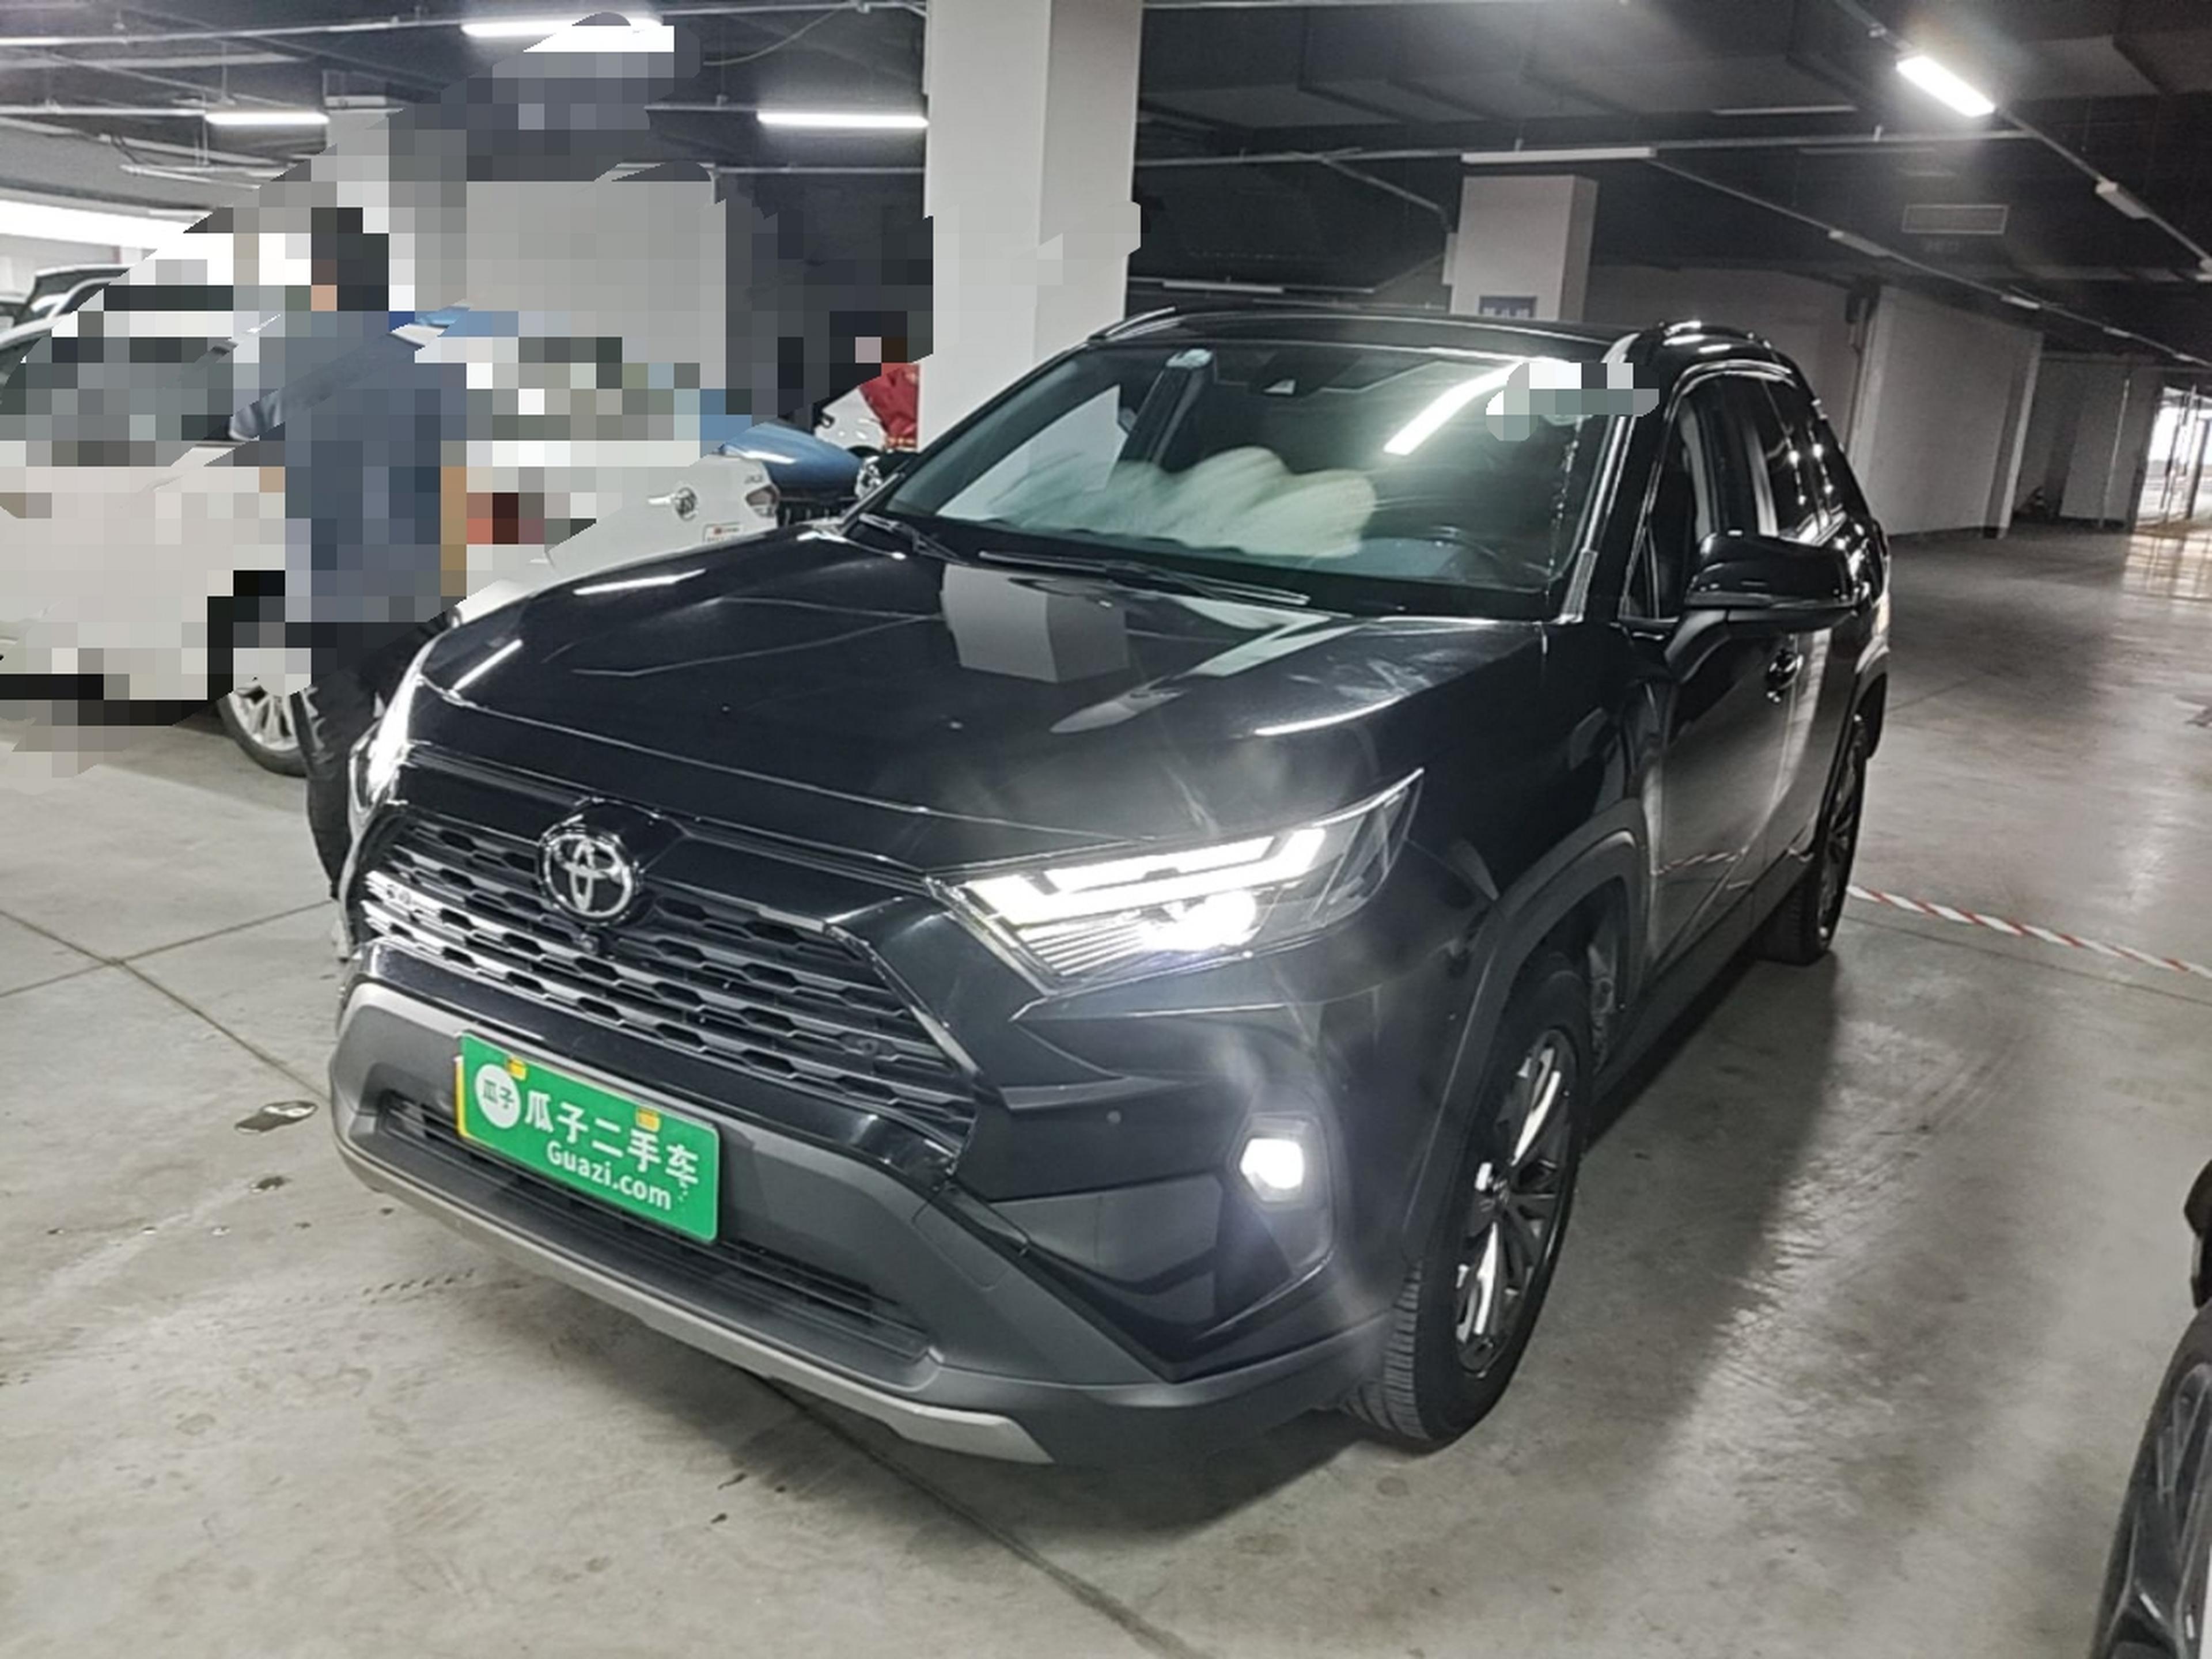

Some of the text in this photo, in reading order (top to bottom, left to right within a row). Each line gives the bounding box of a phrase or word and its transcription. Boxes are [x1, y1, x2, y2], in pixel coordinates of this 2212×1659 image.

[524, 1089, 699, 1190] 瓜子二手车
[547, 1139, 672, 1210] Guazi.com
